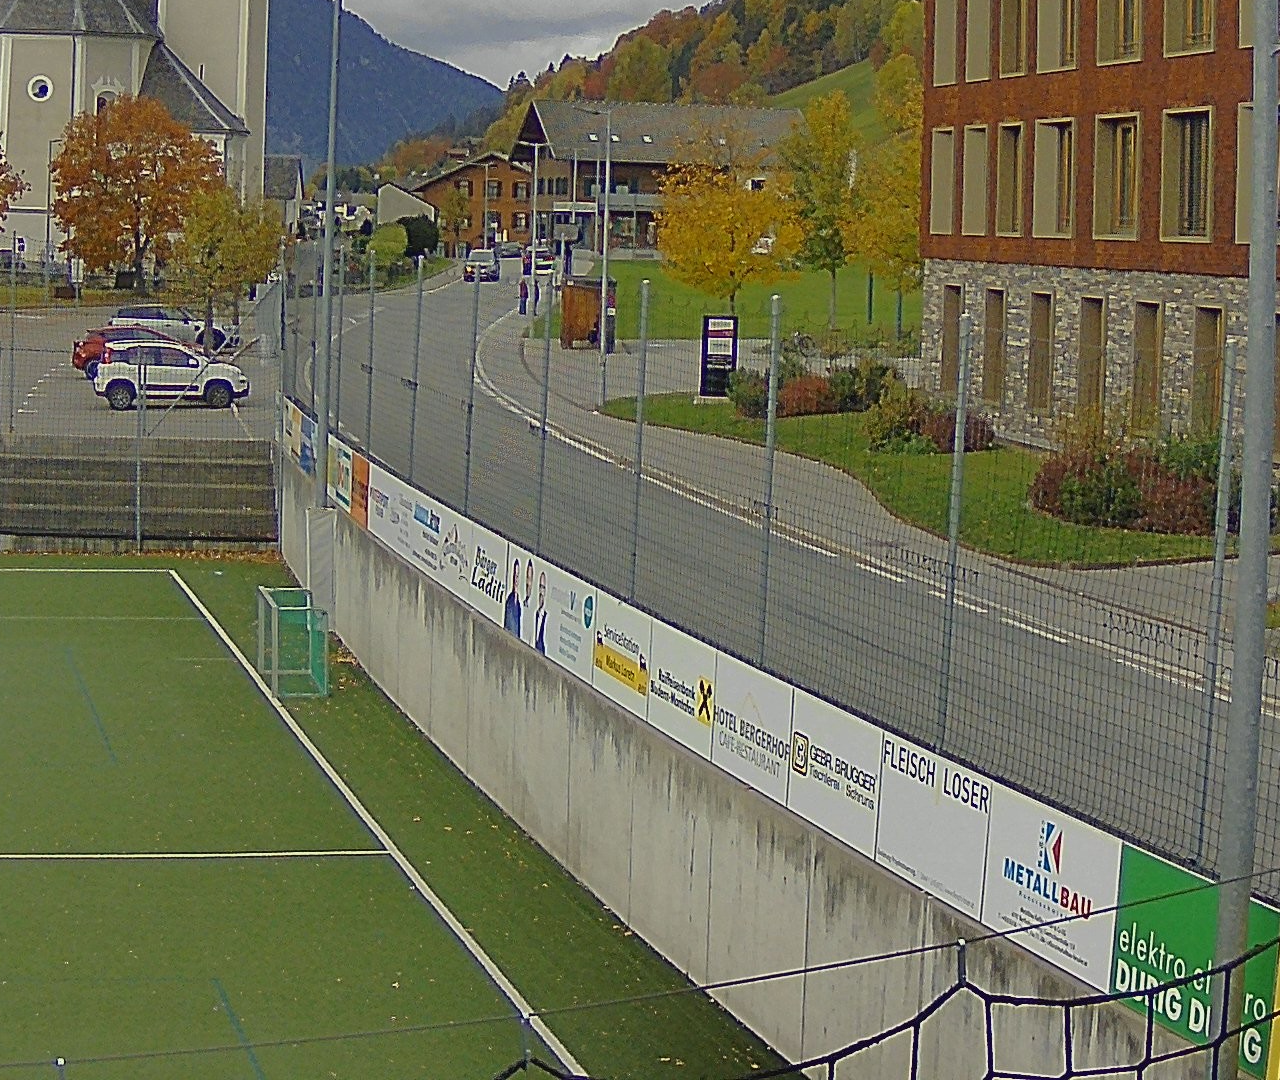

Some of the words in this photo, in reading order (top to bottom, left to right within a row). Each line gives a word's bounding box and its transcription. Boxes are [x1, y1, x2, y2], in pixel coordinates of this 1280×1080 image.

[714, 705, 738, 733] HOTEL
[740, 719, 791, 761] BERGERHOF
[810, 745, 834, 771] GEBR.
[882, 740, 937, 788] FLEISCH
[943, 768, 991, 814] LOSER
[1003, 857, 1092, 920] METALLBAU
[1119, 922, 1186, 981] elektro
